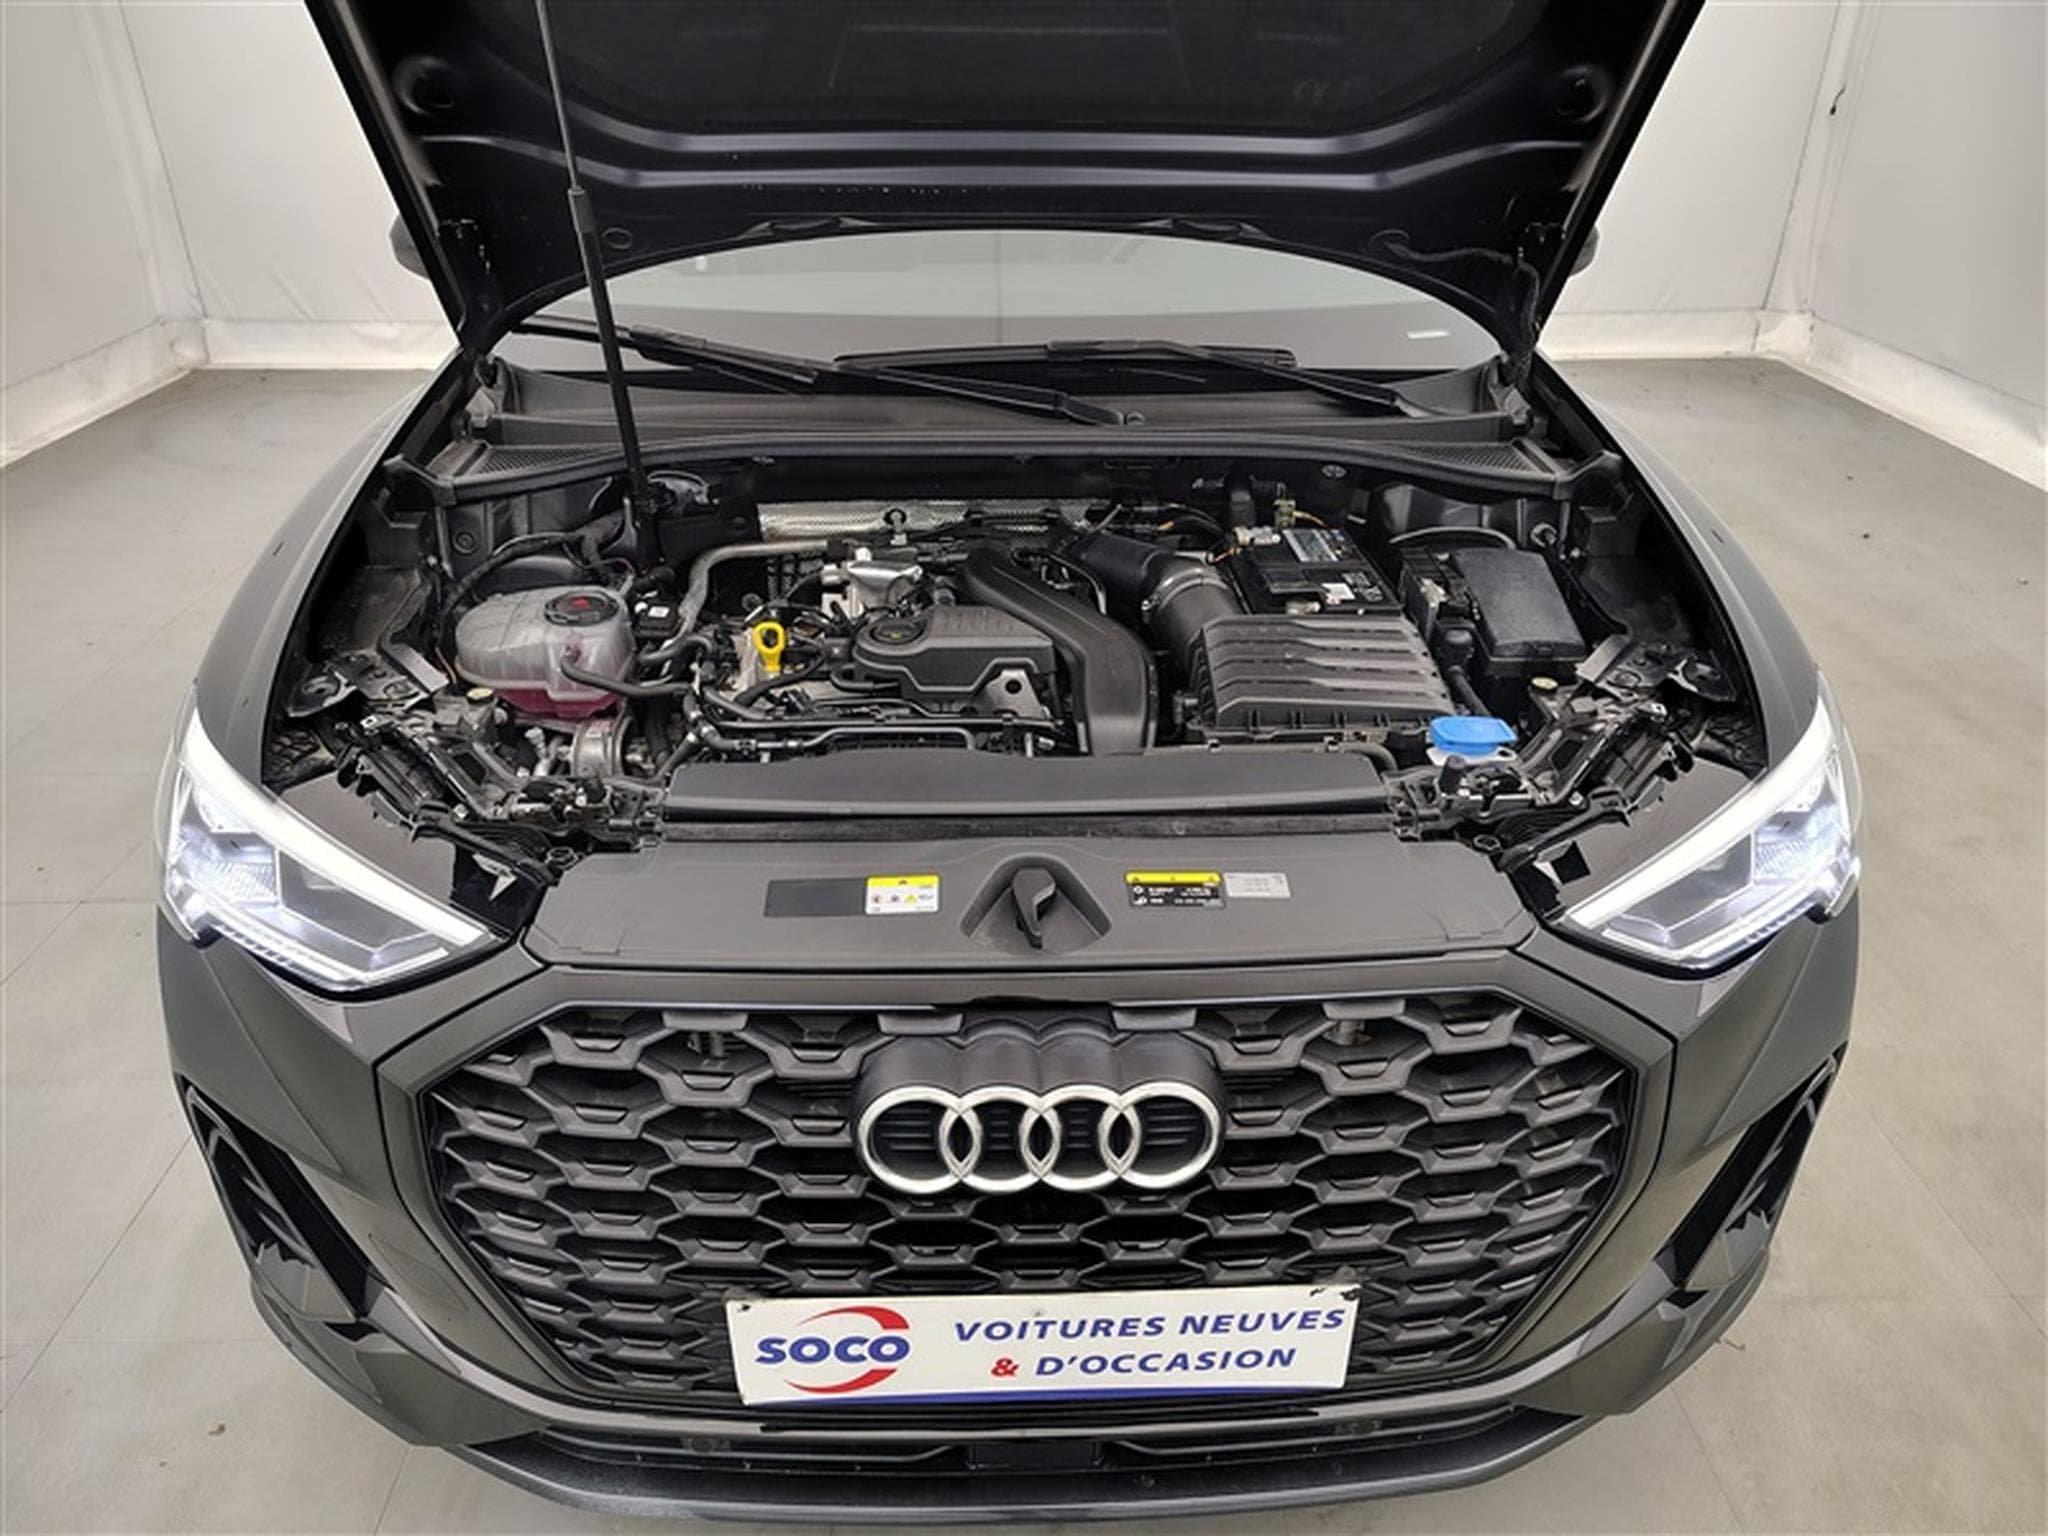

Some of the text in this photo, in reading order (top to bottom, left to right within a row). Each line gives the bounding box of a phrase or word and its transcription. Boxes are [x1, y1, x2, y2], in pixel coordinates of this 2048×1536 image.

[955, 1308, 1346, 1342] VOITURES NEUVES
[755, 1335, 911, 1365] SOCO
[990, 1357, 1019, 1378] &
